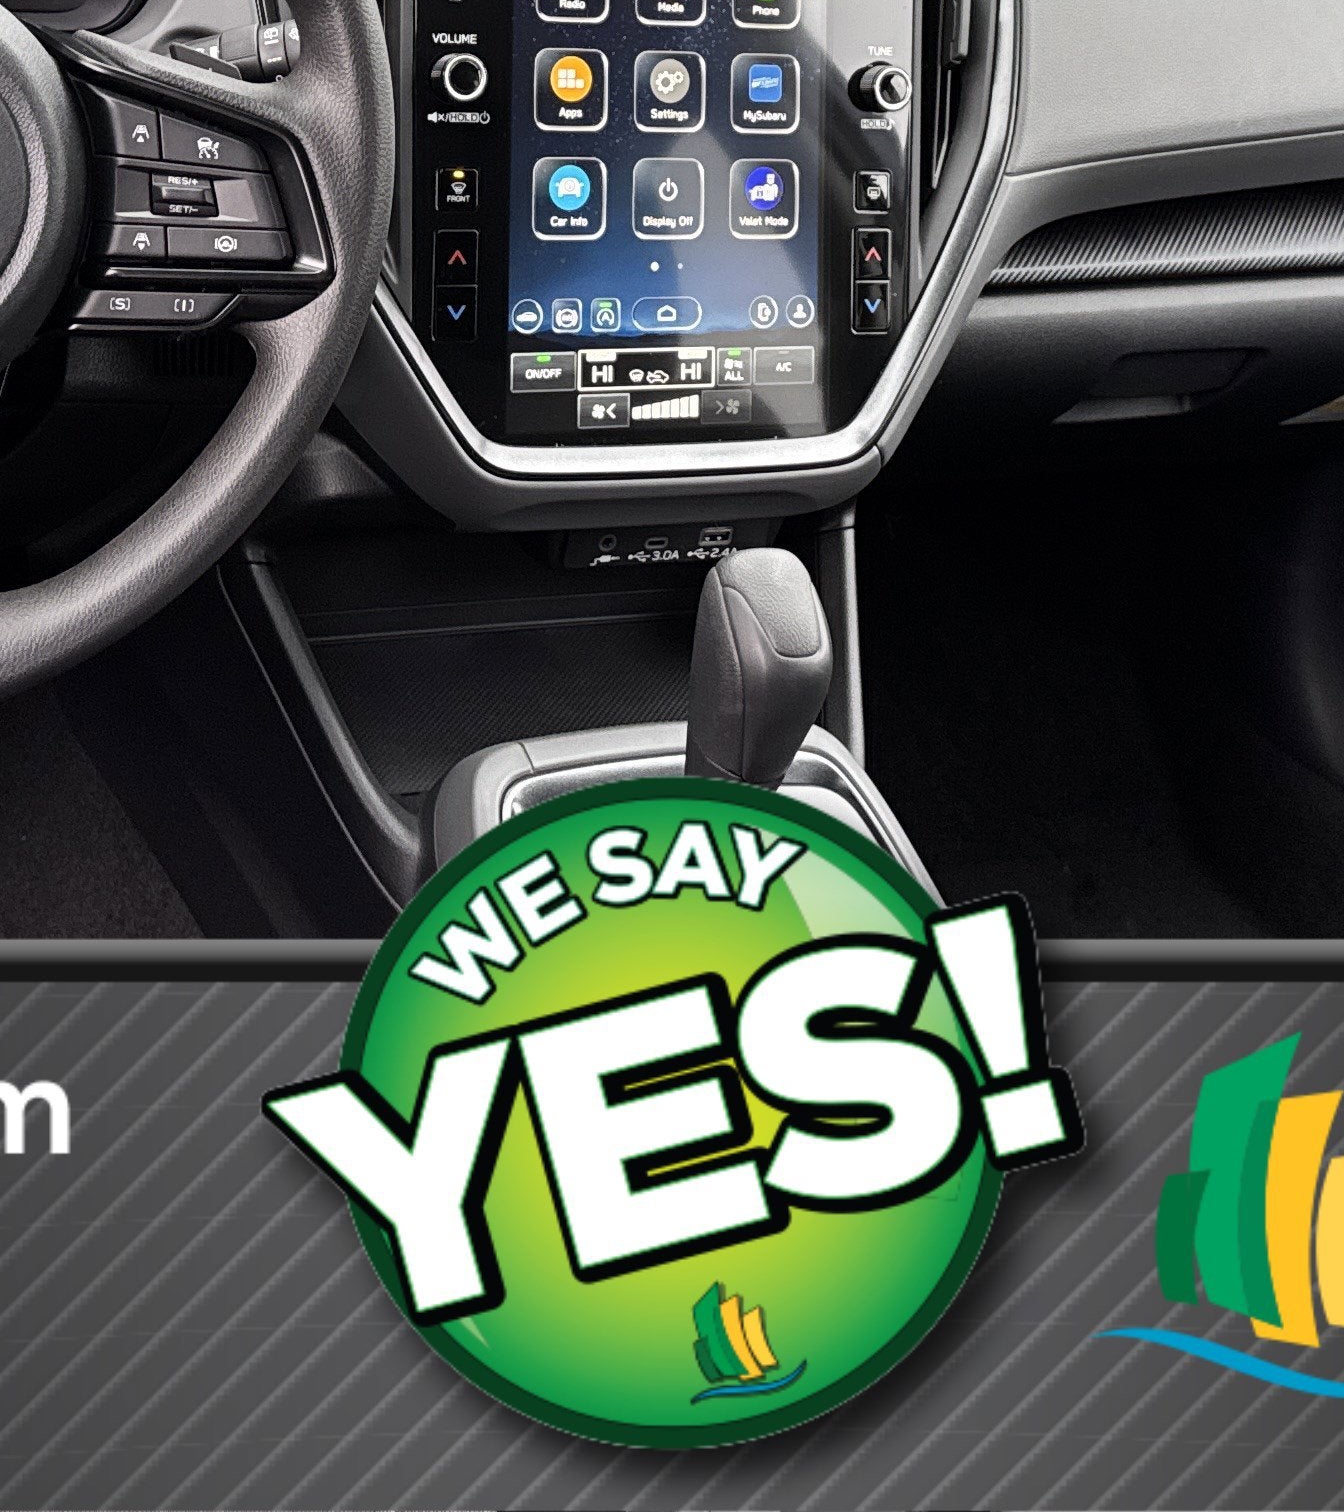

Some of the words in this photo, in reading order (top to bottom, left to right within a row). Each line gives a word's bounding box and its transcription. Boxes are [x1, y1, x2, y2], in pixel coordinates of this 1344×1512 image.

[658, 1, 685, 14] Media
[752, 4, 780, 17] Phone
[432, 32, 478, 45] VOLUME
[867, 45, 894, 57] TUNE
[558, 107, 583, 119] Apps
[650, 108, 689, 123] Settings
[743, 109, 787, 124] MySubaru
[446, 194, 470, 203] FRONT
[549, 215, 570, 228] Car
[571, 215, 588, 228] Info
[643, 216, 677, 229] Display
[678, 215, 694, 227] Off
[739, 216, 763, 227] Valet
[765, 216, 789, 228] Mode
[680, 362, 702, 381] HI
[775, 361, 792, 373] A/C
[525, 368, 562, 380] ON/OFF
[591, 364, 613, 384] HI
[724, 370, 745, 382] ALL
